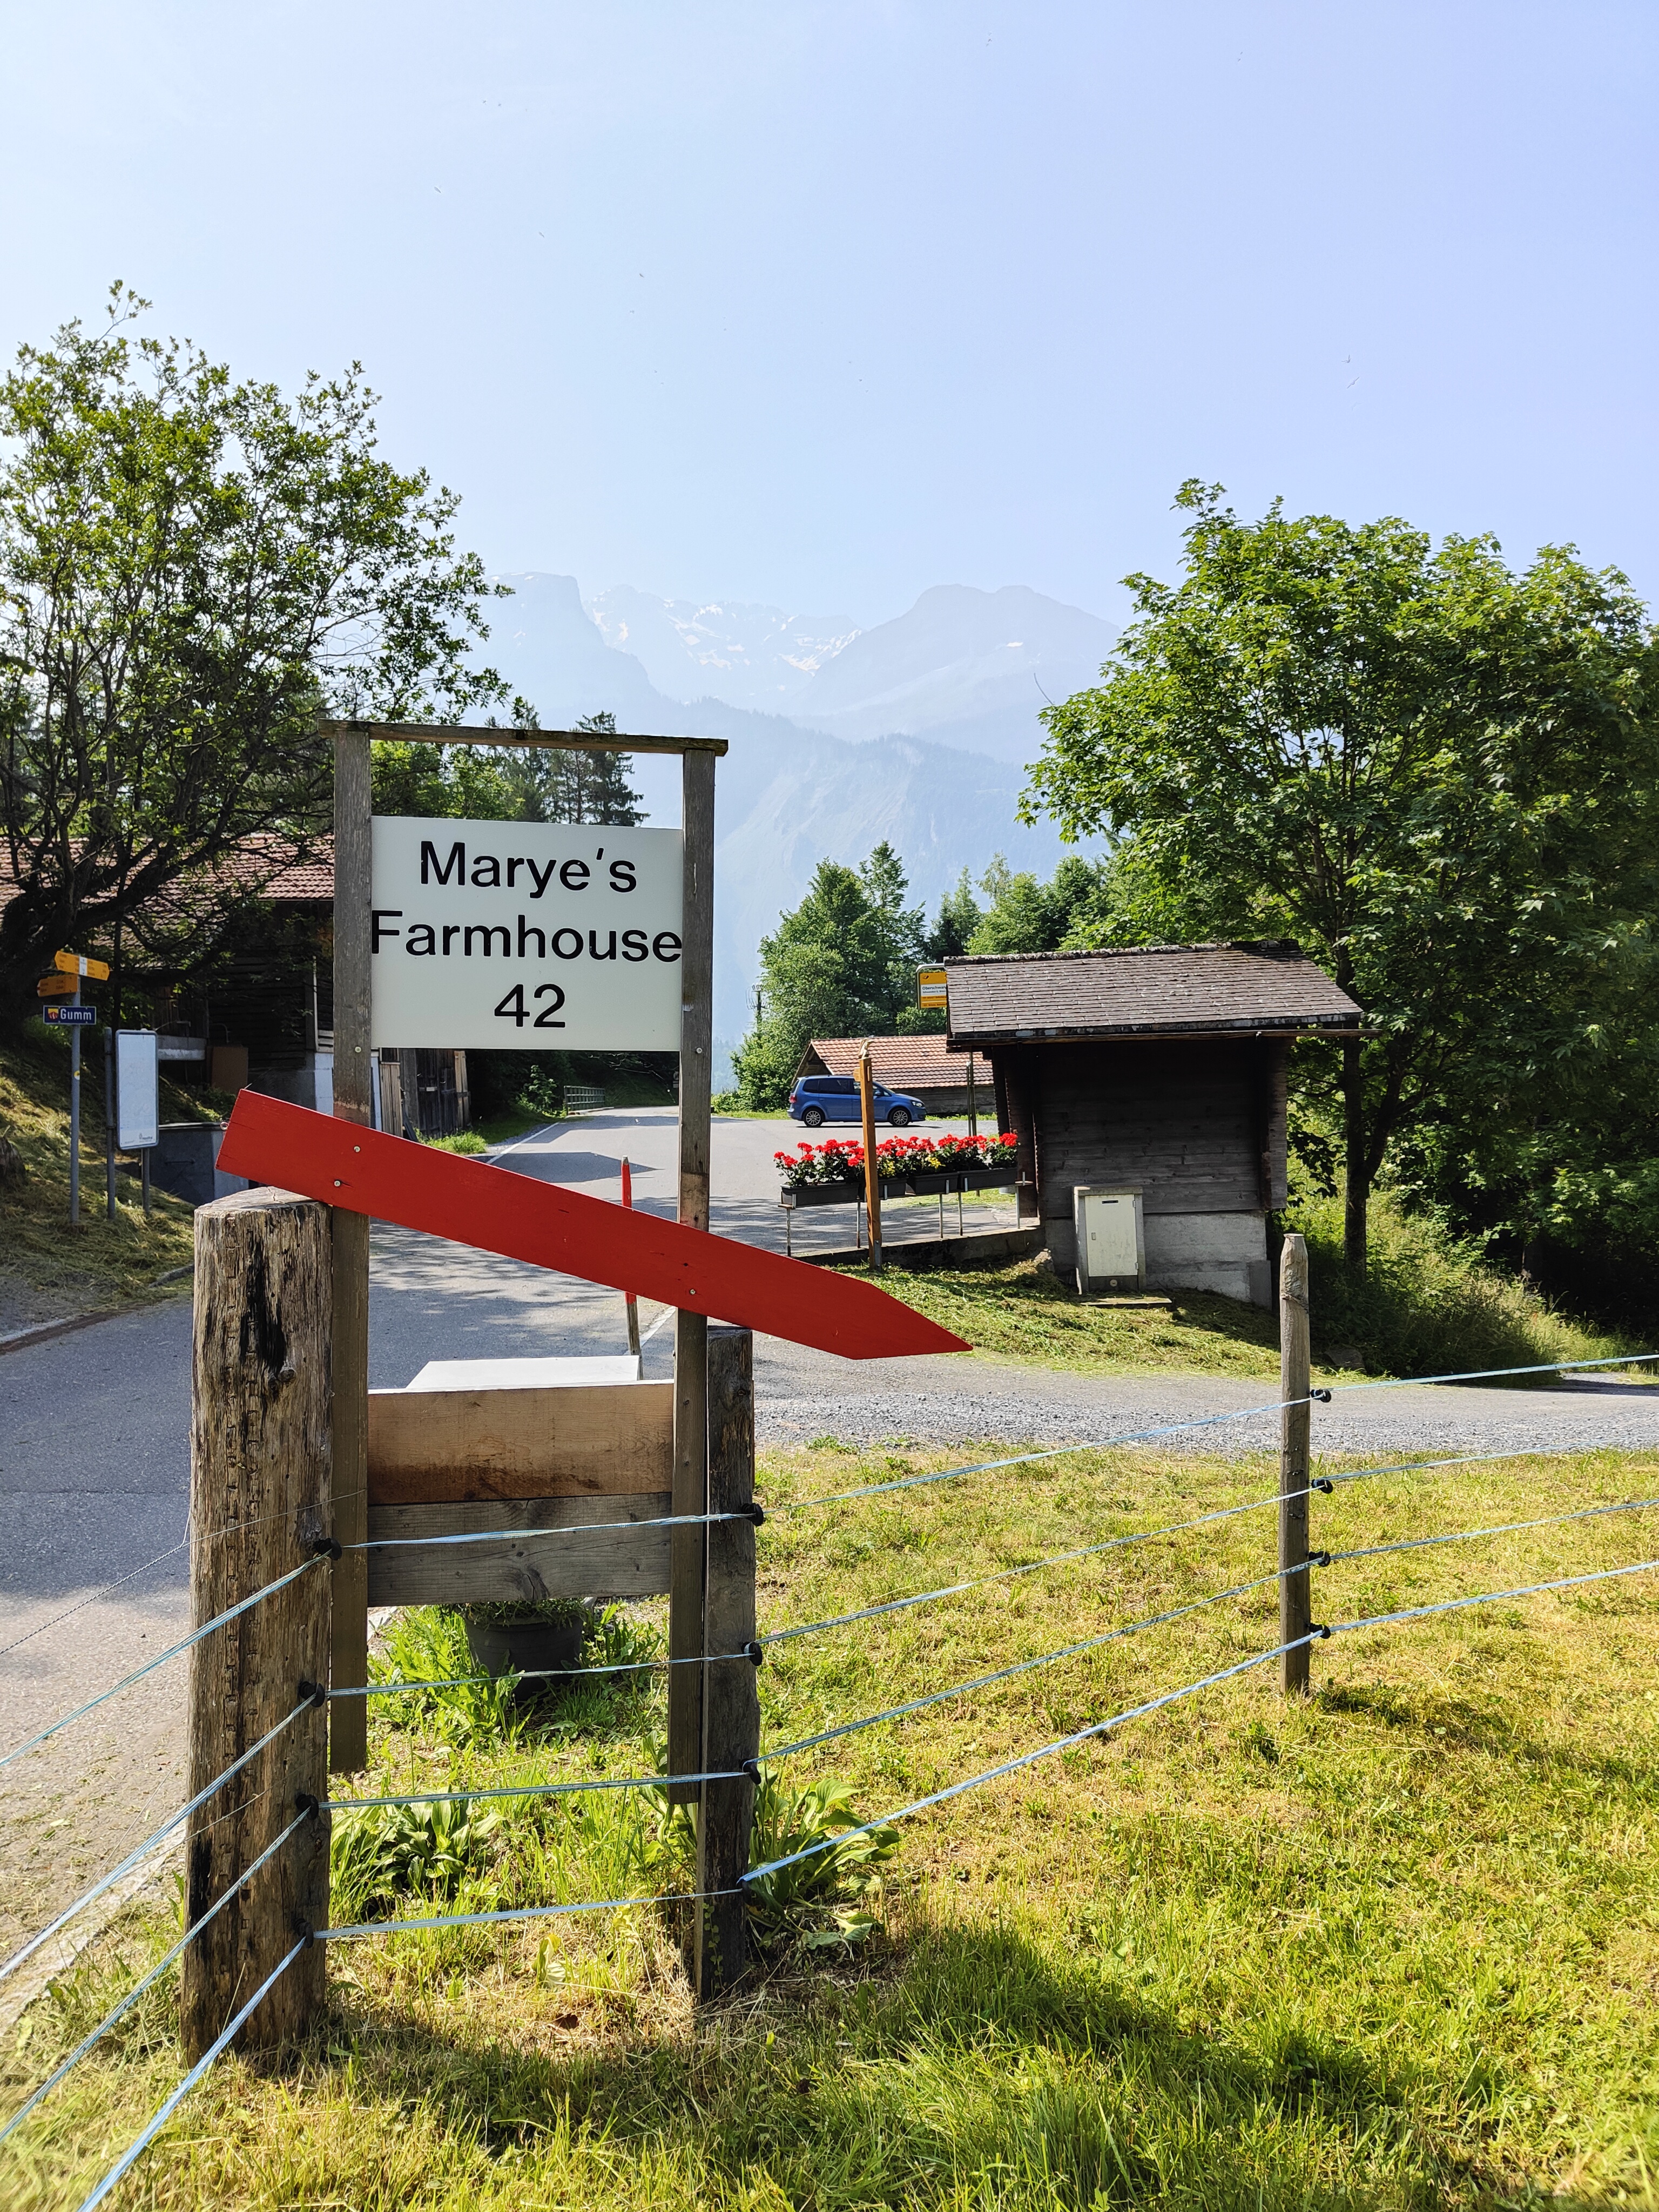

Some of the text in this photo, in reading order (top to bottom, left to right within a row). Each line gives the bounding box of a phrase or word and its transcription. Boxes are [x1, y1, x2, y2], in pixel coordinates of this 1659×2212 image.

[421, 841, 637, 899] Marye's
[371, 909, 682, 962] Farmhouse
[60, 1008, 91, 1020] Gumm
[494, 983, 565, 1028] 42
